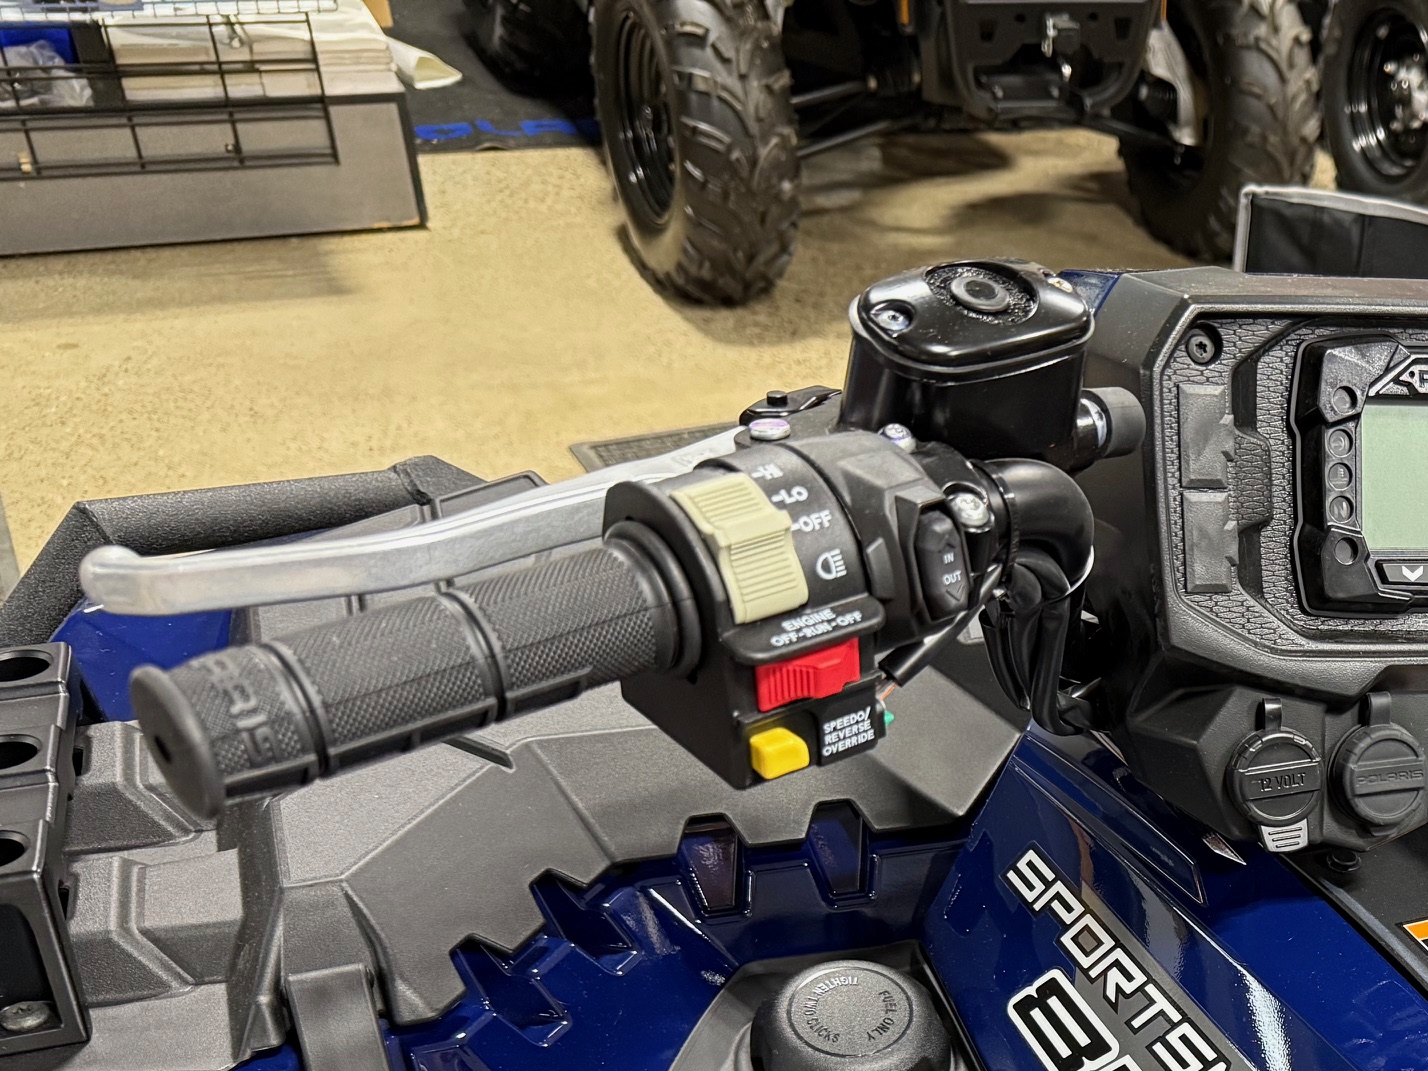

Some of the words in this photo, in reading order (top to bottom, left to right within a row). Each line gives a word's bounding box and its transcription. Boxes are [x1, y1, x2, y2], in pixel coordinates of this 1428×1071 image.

[799, 509, 832, 533] OFF
[943, 552, 955, 564] IN
[943, 570, 962, 586] OUT
[781, 608, 836, 632] ENGINE
[823, 706, 871, 733] SPEEDO/
[822, 730, 875, 757] OVERRIDE
[824, 720, 872, 744] REVERSE
[1260, 777, 1272, 792] 12
[1276, 773, 1306, 790] VOLT
[1356, 769, 1424, 787] POLARIS
[814, 976, 859, 998] TIGHTEN
[802, 996, 819, 1016] TWO
[879, 990, 897, 1015] FUEL
[806, 1016, 840, 1043] CLICKS
[867, 1017, 895, 1041] ONLY
